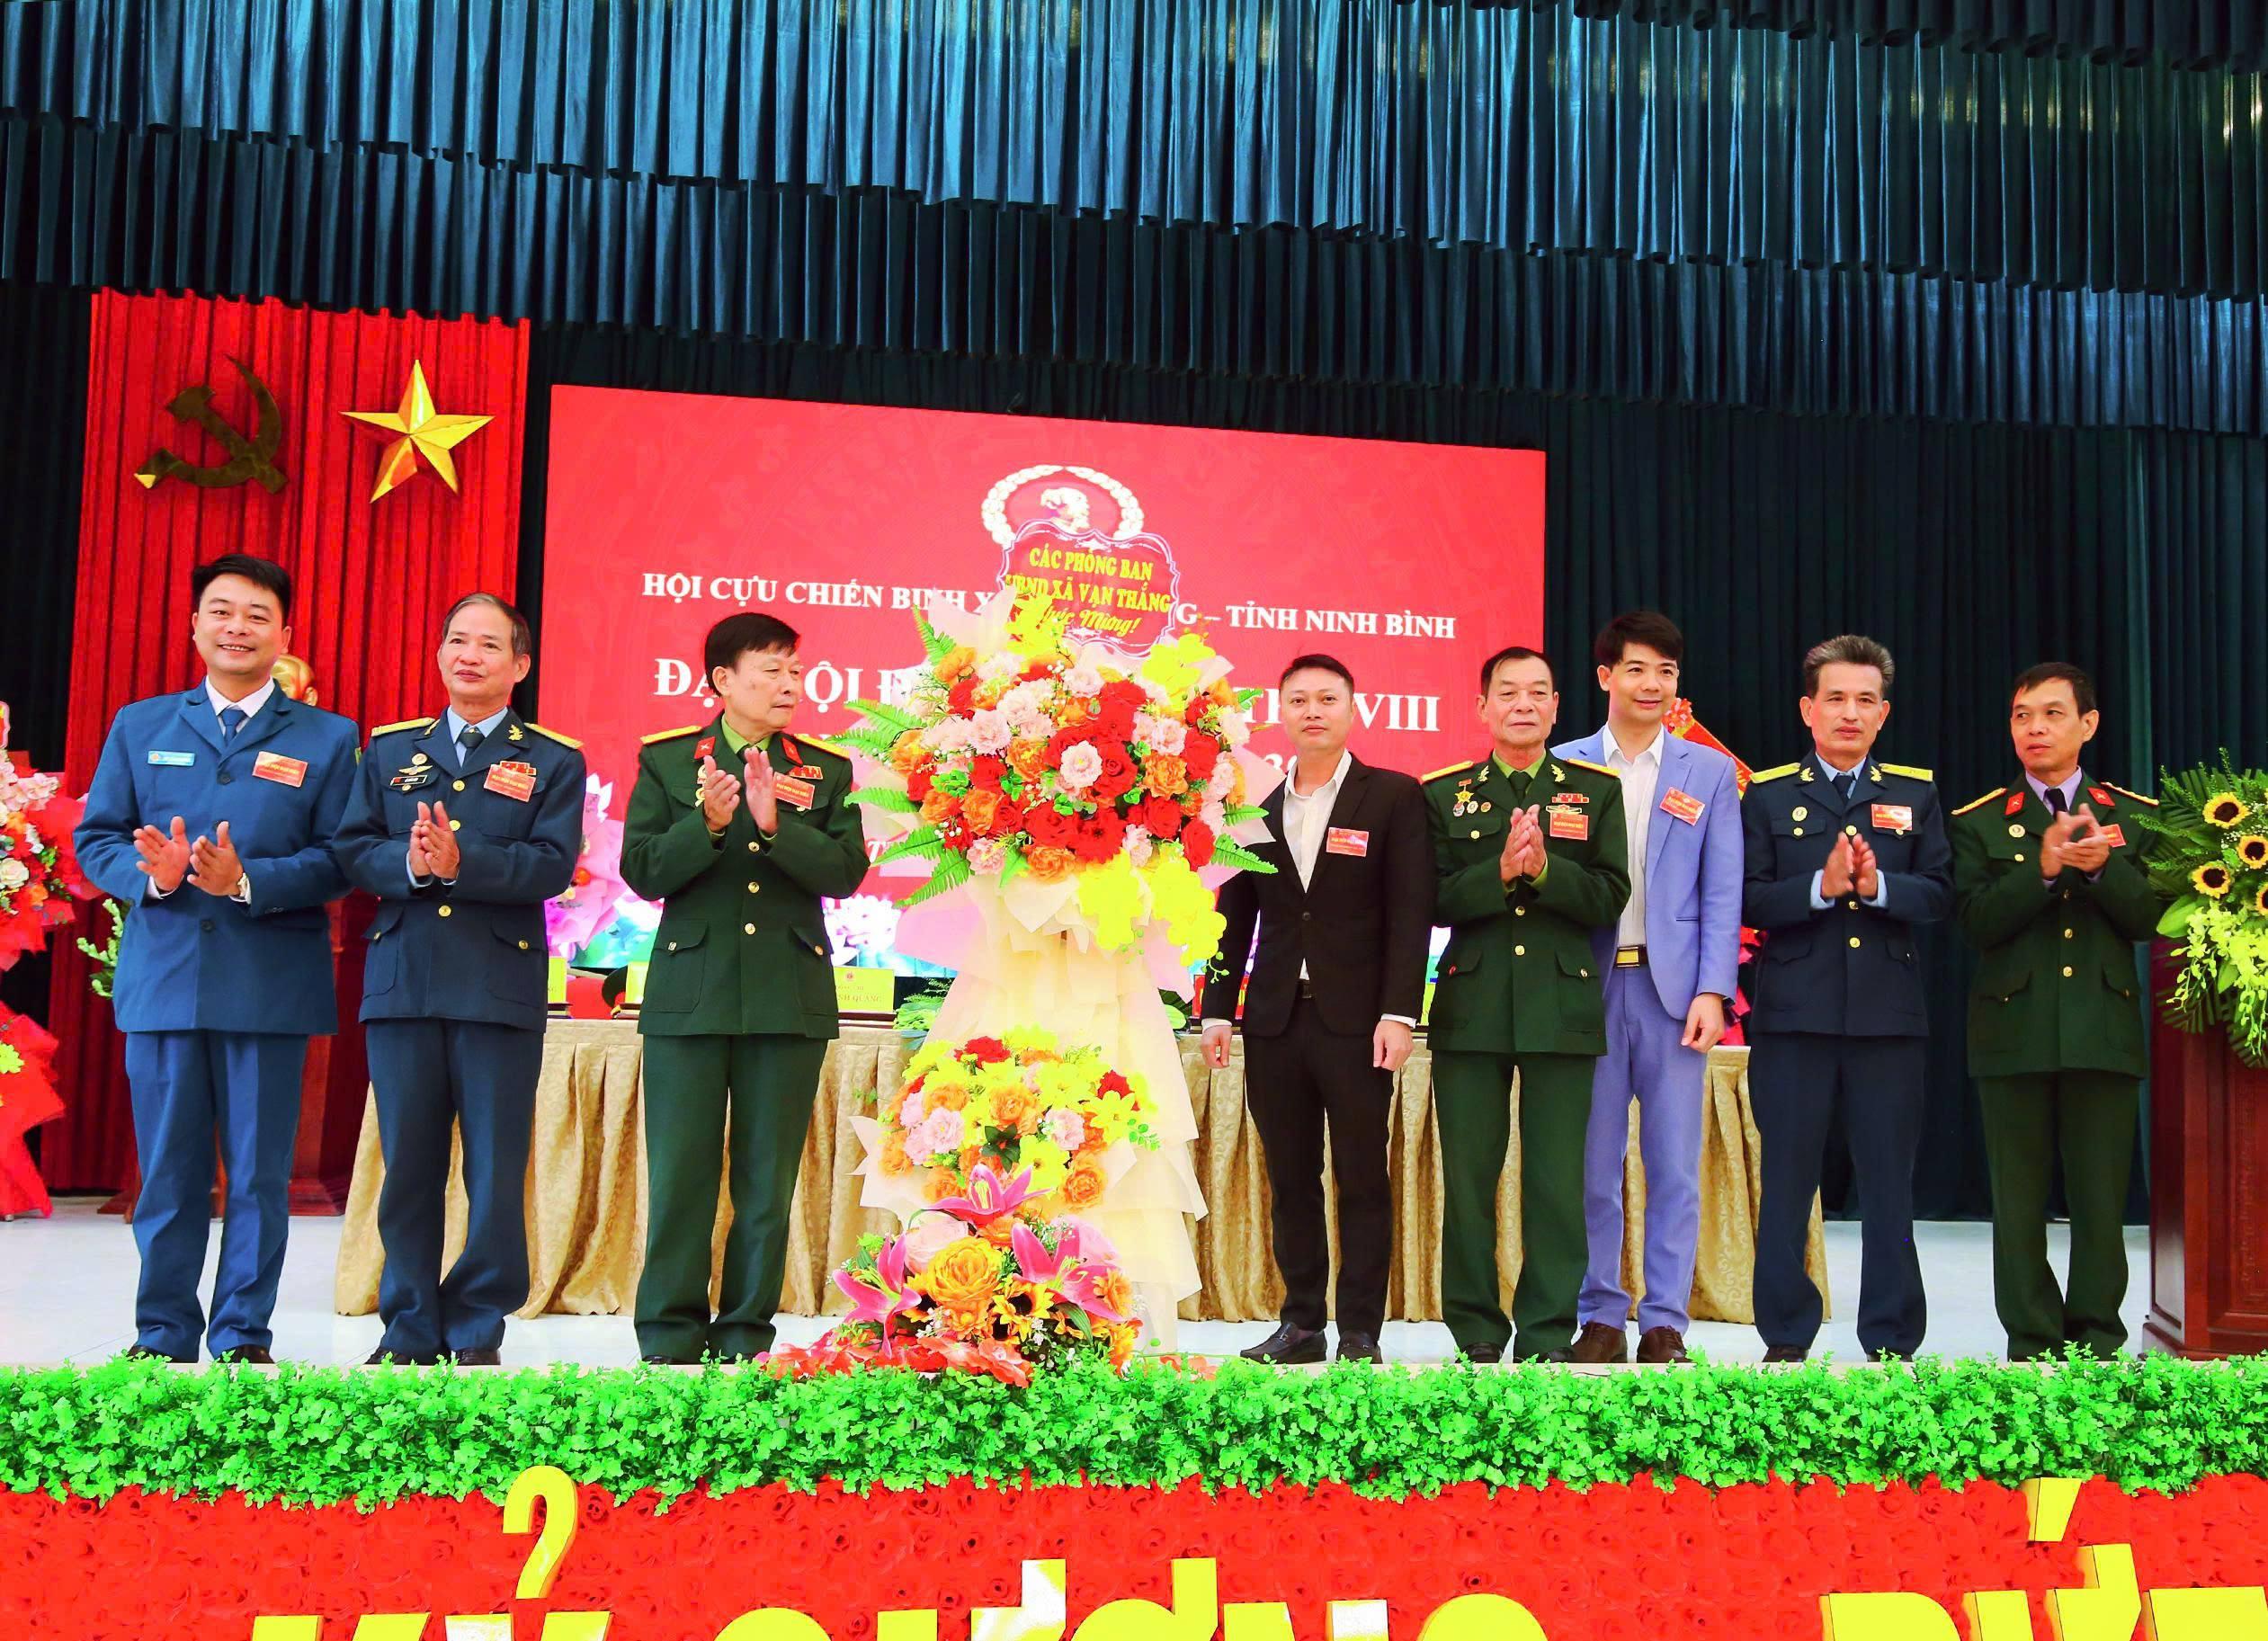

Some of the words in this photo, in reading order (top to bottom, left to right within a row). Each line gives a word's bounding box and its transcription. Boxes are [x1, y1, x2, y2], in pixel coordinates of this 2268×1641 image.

[1029, 543, 1062, 569] CÁC
[1119, 558, 1155, 582] BAN
[642, 573, 703, 603] HỘI
[710, 575, 778, 607] CỰU
[785, 578, 884, 608] CHIẾN
[1051, 576, 1074, 602] XÃ
[1078, 583, 1113, 609] VẠN
[1116, 582, 1171, 613] THẮNG
[1226, 601, 1299, 630] TỈNH
[1305, 610, 1379, 635] NINH
[1385, 610, 1457, 638] BÌNH
[653, 658, 719, 709] ĐẠ
[799, 660, 864, 713] ỘI
[1353, 692, 1441, 732] VIII
